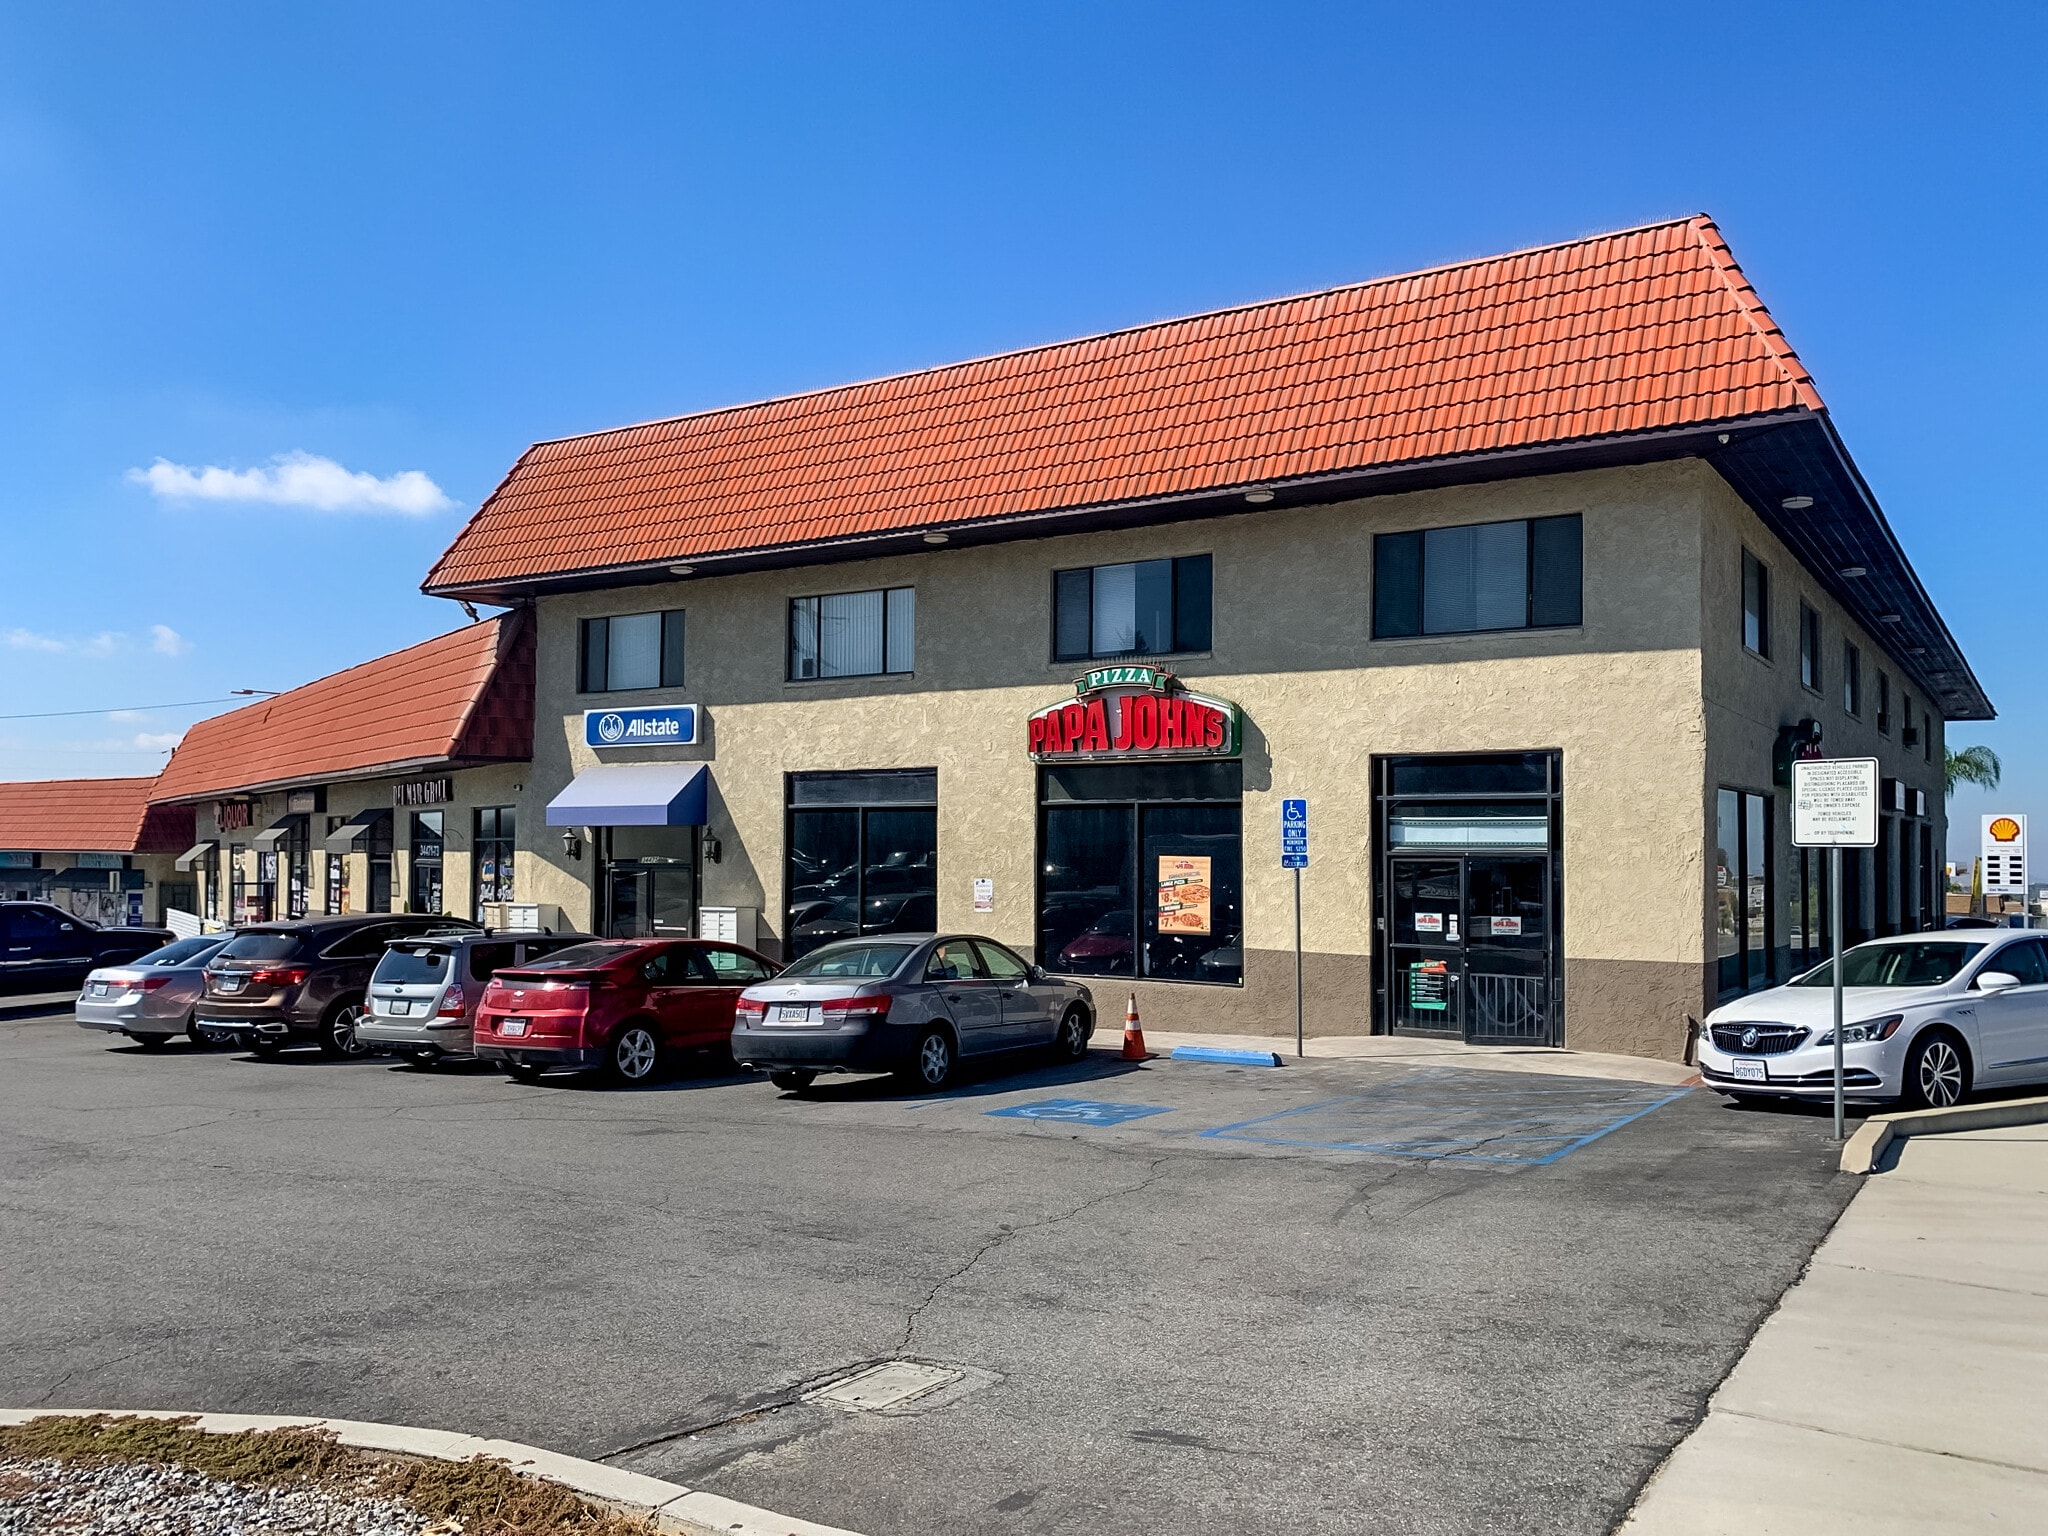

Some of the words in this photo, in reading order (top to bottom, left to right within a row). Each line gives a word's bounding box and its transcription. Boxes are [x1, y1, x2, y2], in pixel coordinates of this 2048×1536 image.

[1091, 668, 1150, 686] PIZZA
[626, 718, 679, 737] Allstate
[1029, 697, 1109, 753] PAPA
[1114, 695, 1223, 750] JOHN'S
[406, 782, 422, 805] MAR
[424, 780, 446, 803] GRILL
[220, 803, 248, 829] LIQUOR
[1284, 820, 1306, 828] PARKING
